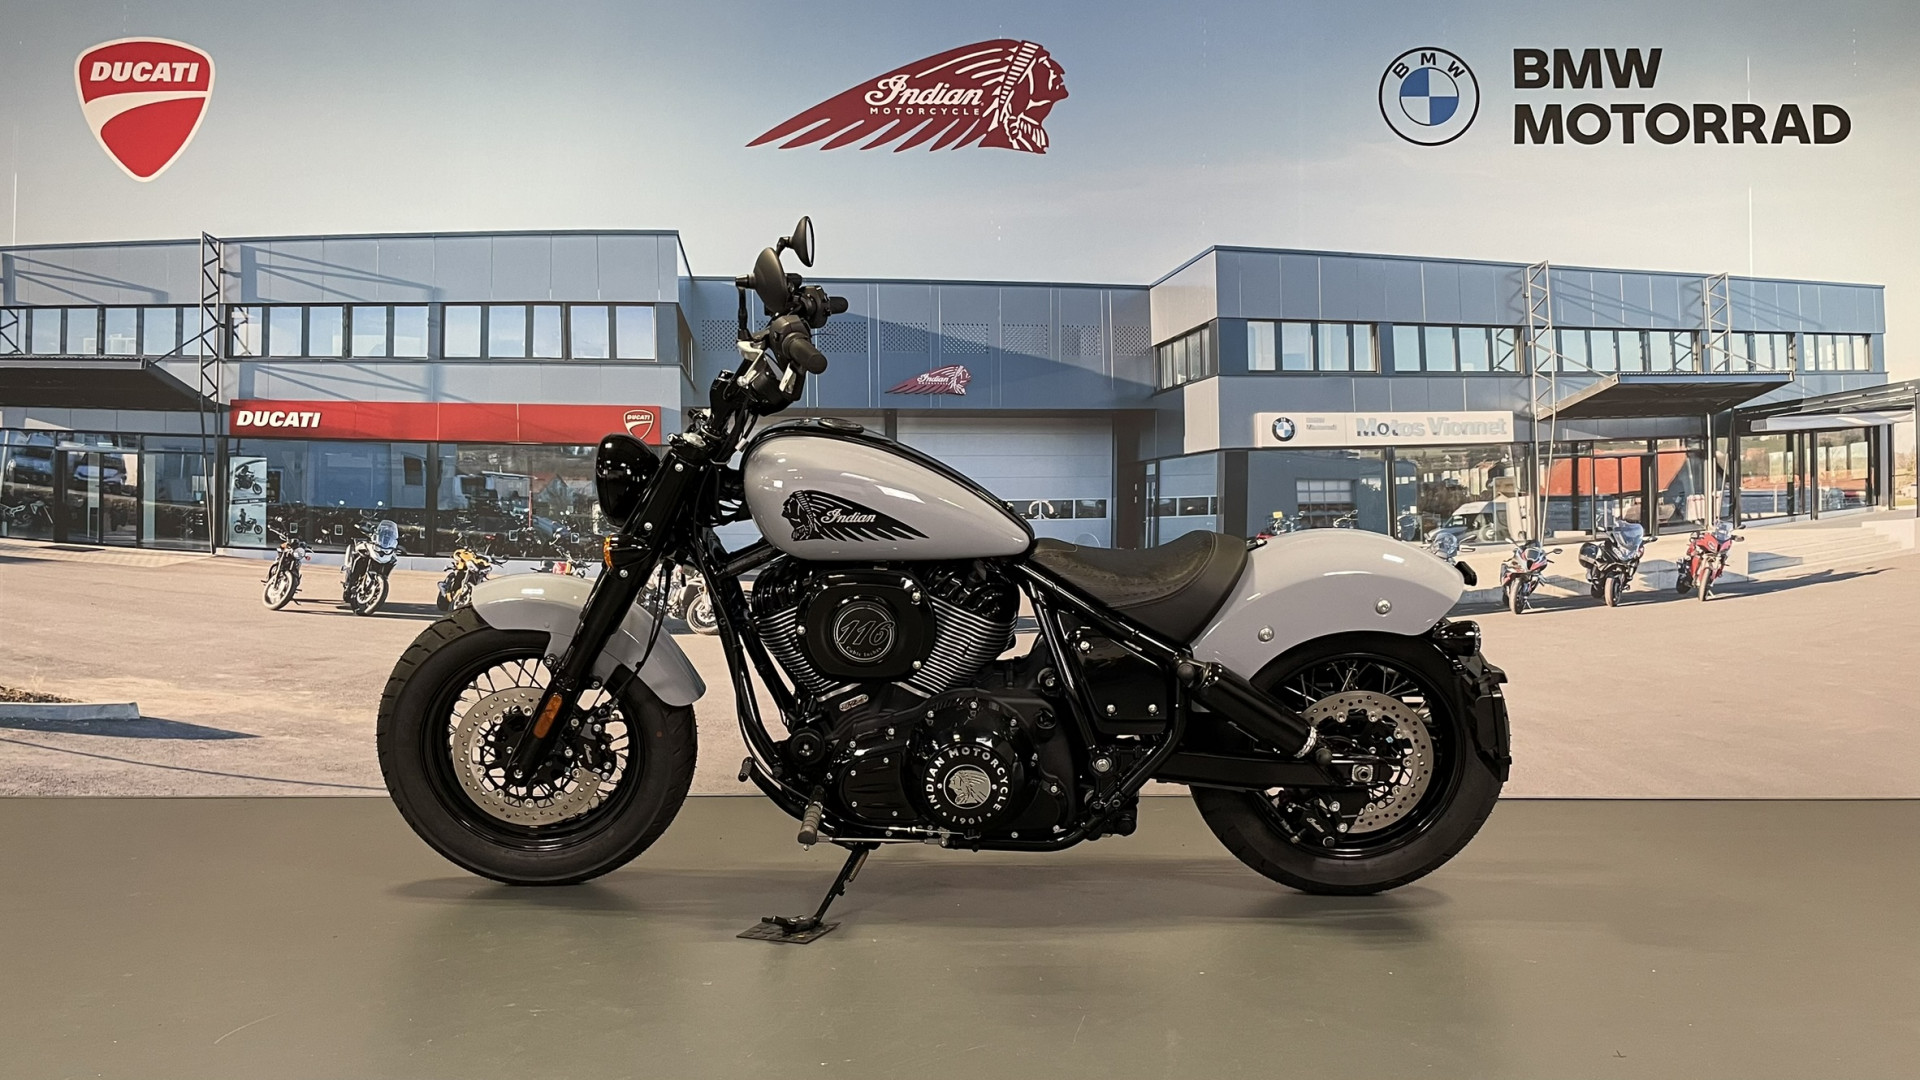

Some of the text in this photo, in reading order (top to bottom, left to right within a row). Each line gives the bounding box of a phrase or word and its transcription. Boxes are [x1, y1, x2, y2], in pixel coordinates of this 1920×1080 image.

[90, 61, 199, 82] DUCATI
[1391, 51, 1466, 79] BMW
[1513, 48, 1662, 89] BMW
[864, 74, 984, 106] Indian
[869, 107, 980, 116] MOTORCYCLE
[1513, 103, 1851, 145] MOTORRAD
[236, 410, 321, 428] DUCATI
[820, 508, 877, 524] Indian
[836, 620, 895, 646] 116
[926, 747, 1009, 811] INDIAN MOTORCYCLE
[951, 815, 982, 824] 1901
